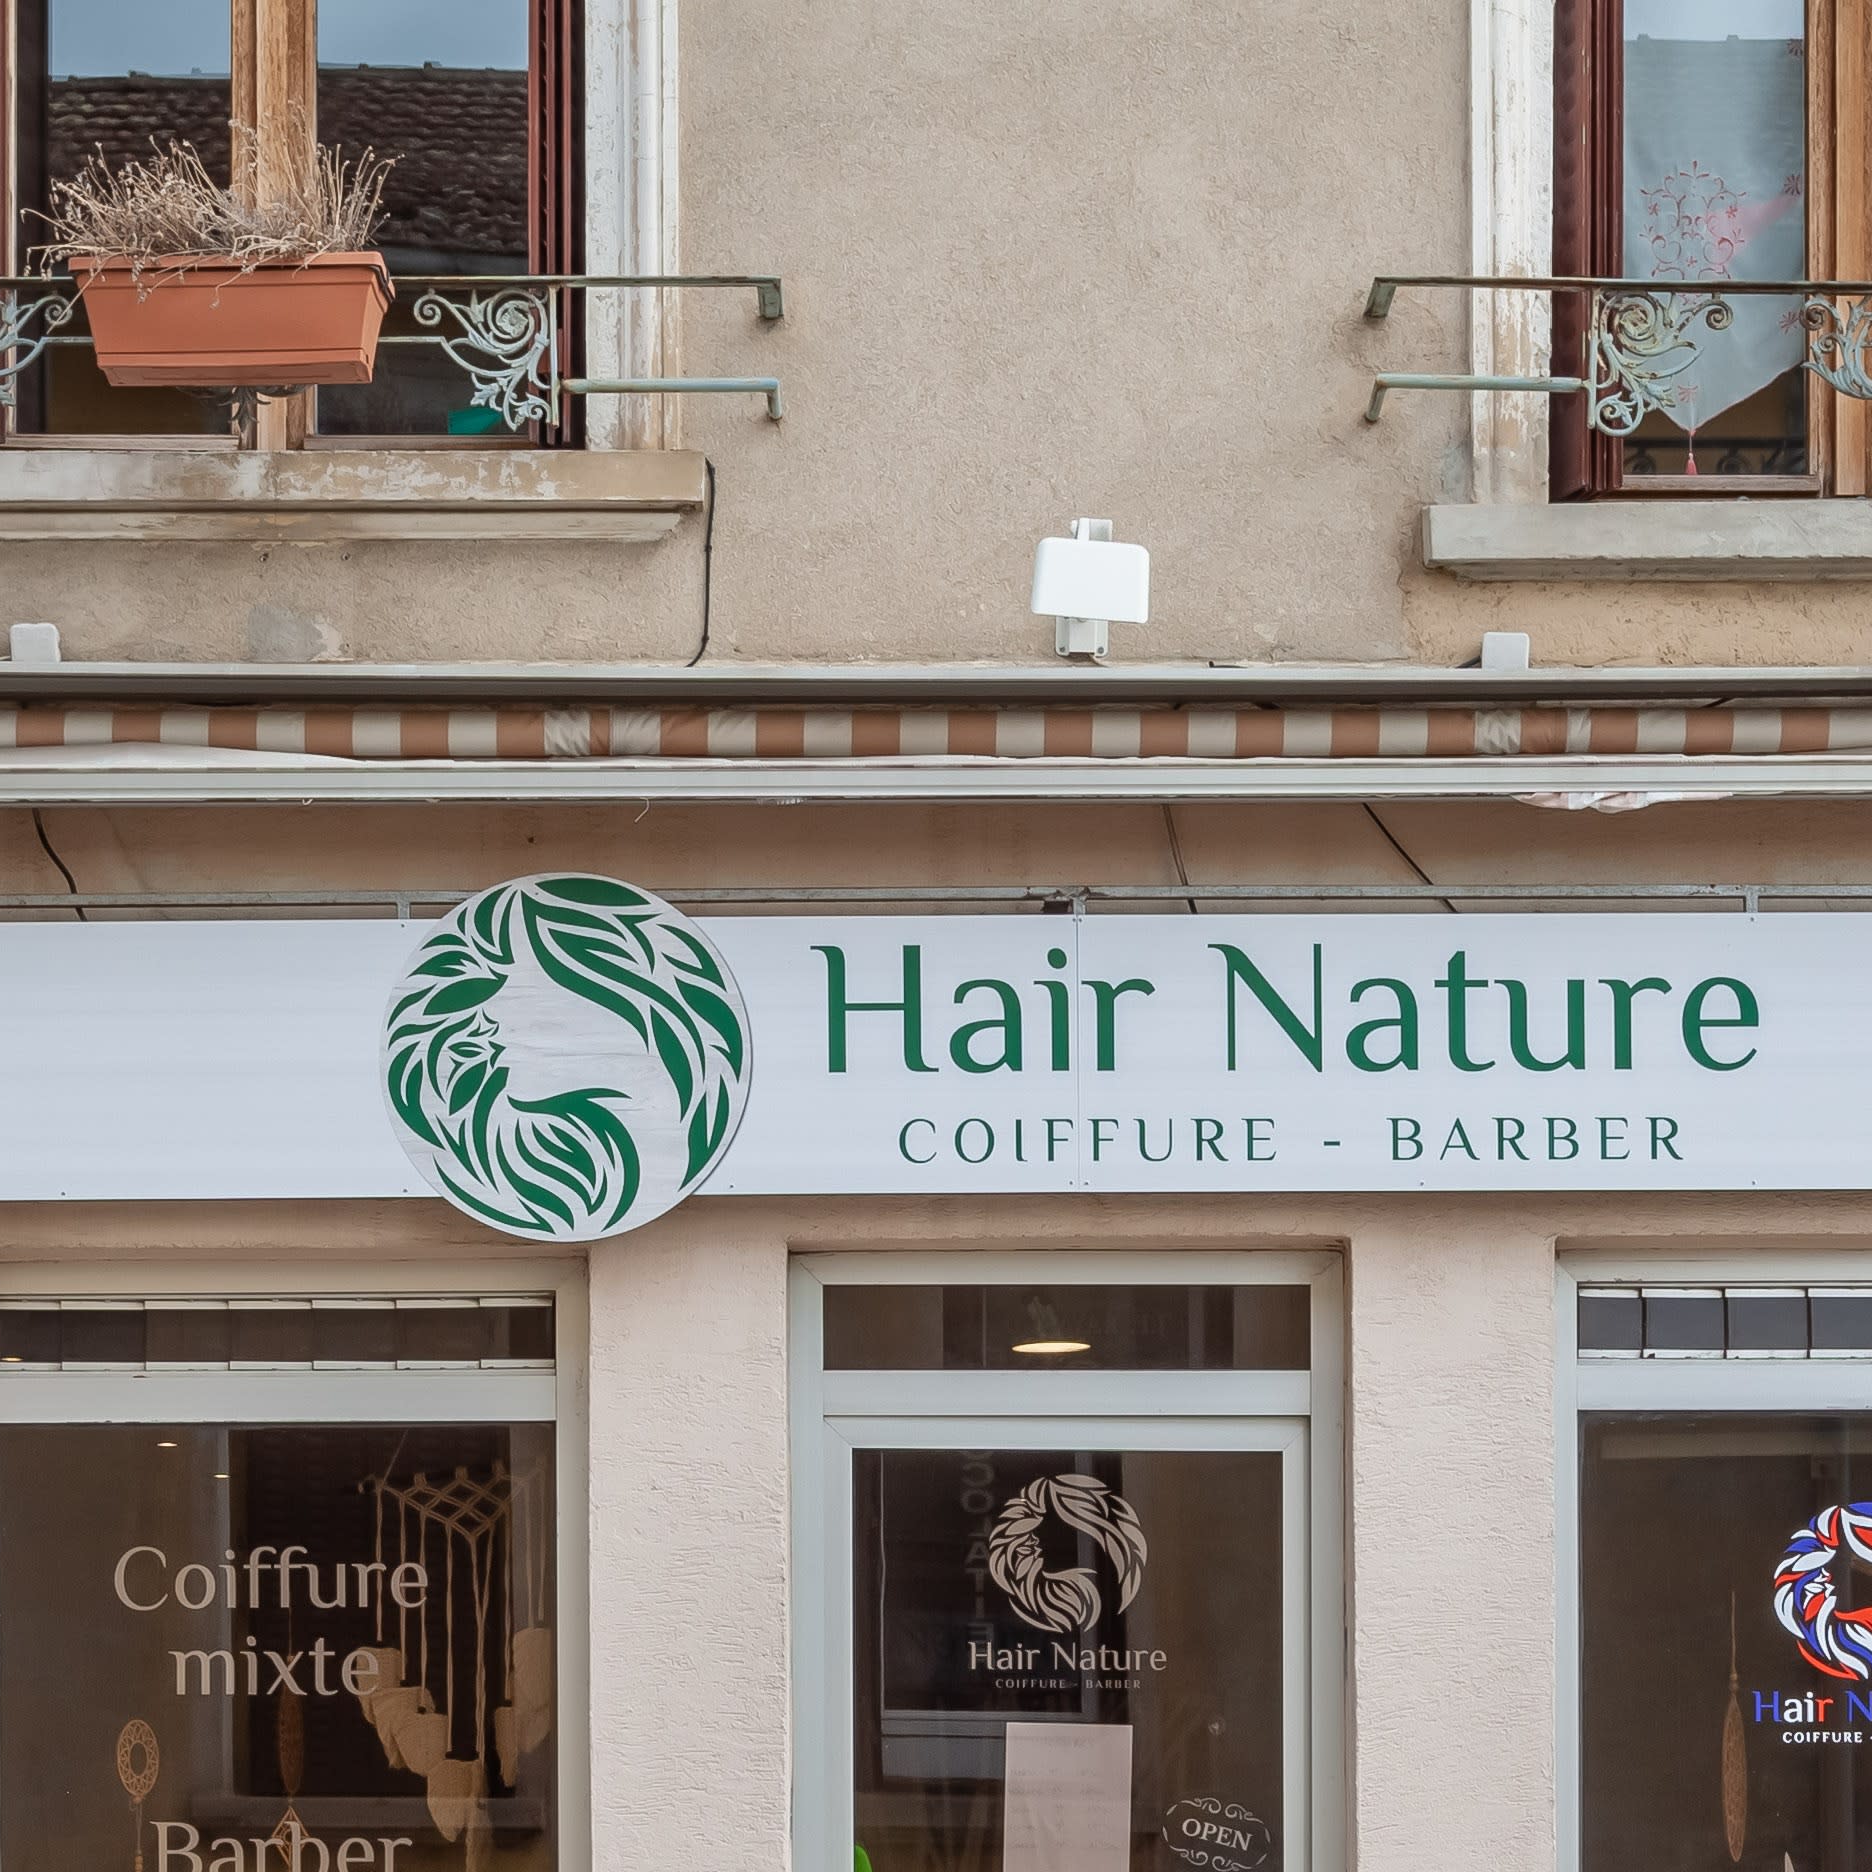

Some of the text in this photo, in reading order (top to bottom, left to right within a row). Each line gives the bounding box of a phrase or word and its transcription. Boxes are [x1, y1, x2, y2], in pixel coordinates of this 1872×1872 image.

[809, 943, 1760, 1074] Hair Nature
[898, 1116, 1278, 1164] COIFFURE
[1386, 1116, 1686, 1163] BARBER
[113, 1546, 430, 1612] Coiffure
[167, 1635, 382, 1698] mixte
[967, 1641, 1168, 1671] Hair Nature
[995, 1678, 1067, 1689] COIFFURE
[1085, 1678, 1142, 1689] BARBER
[1752, 1690, 1835, 1723] Hair
[1782, 1731, 1864, 1744] COIFFURE
[1181, 1818, 1253, 1852] OPEN
